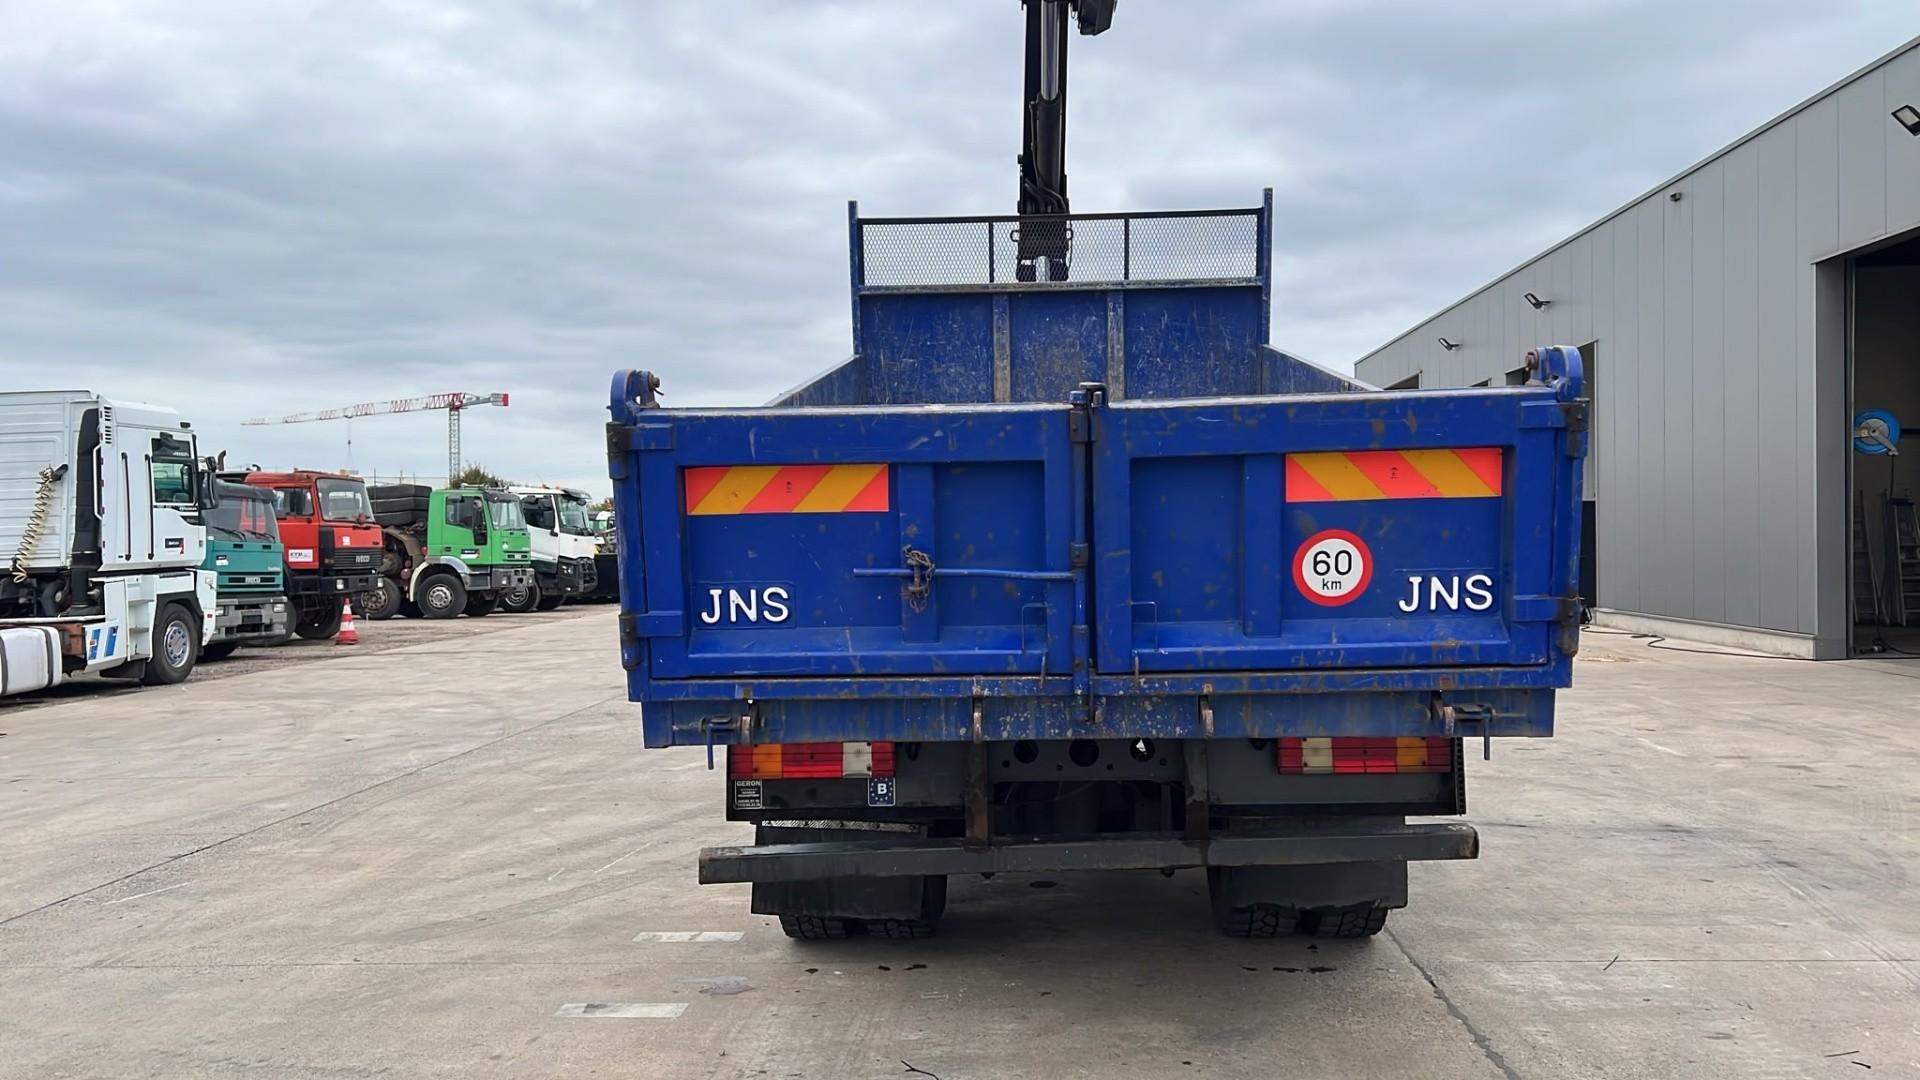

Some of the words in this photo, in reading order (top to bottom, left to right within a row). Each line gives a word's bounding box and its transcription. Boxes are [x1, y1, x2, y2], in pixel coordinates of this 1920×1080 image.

[1312, 549, 1353, 576] 60
[1321, 578, 1342, 591] km
[1398, 574, 1494, 613] JNS
[701, 586, 789, 624] JNS
[877, 783, 888, 795] B
